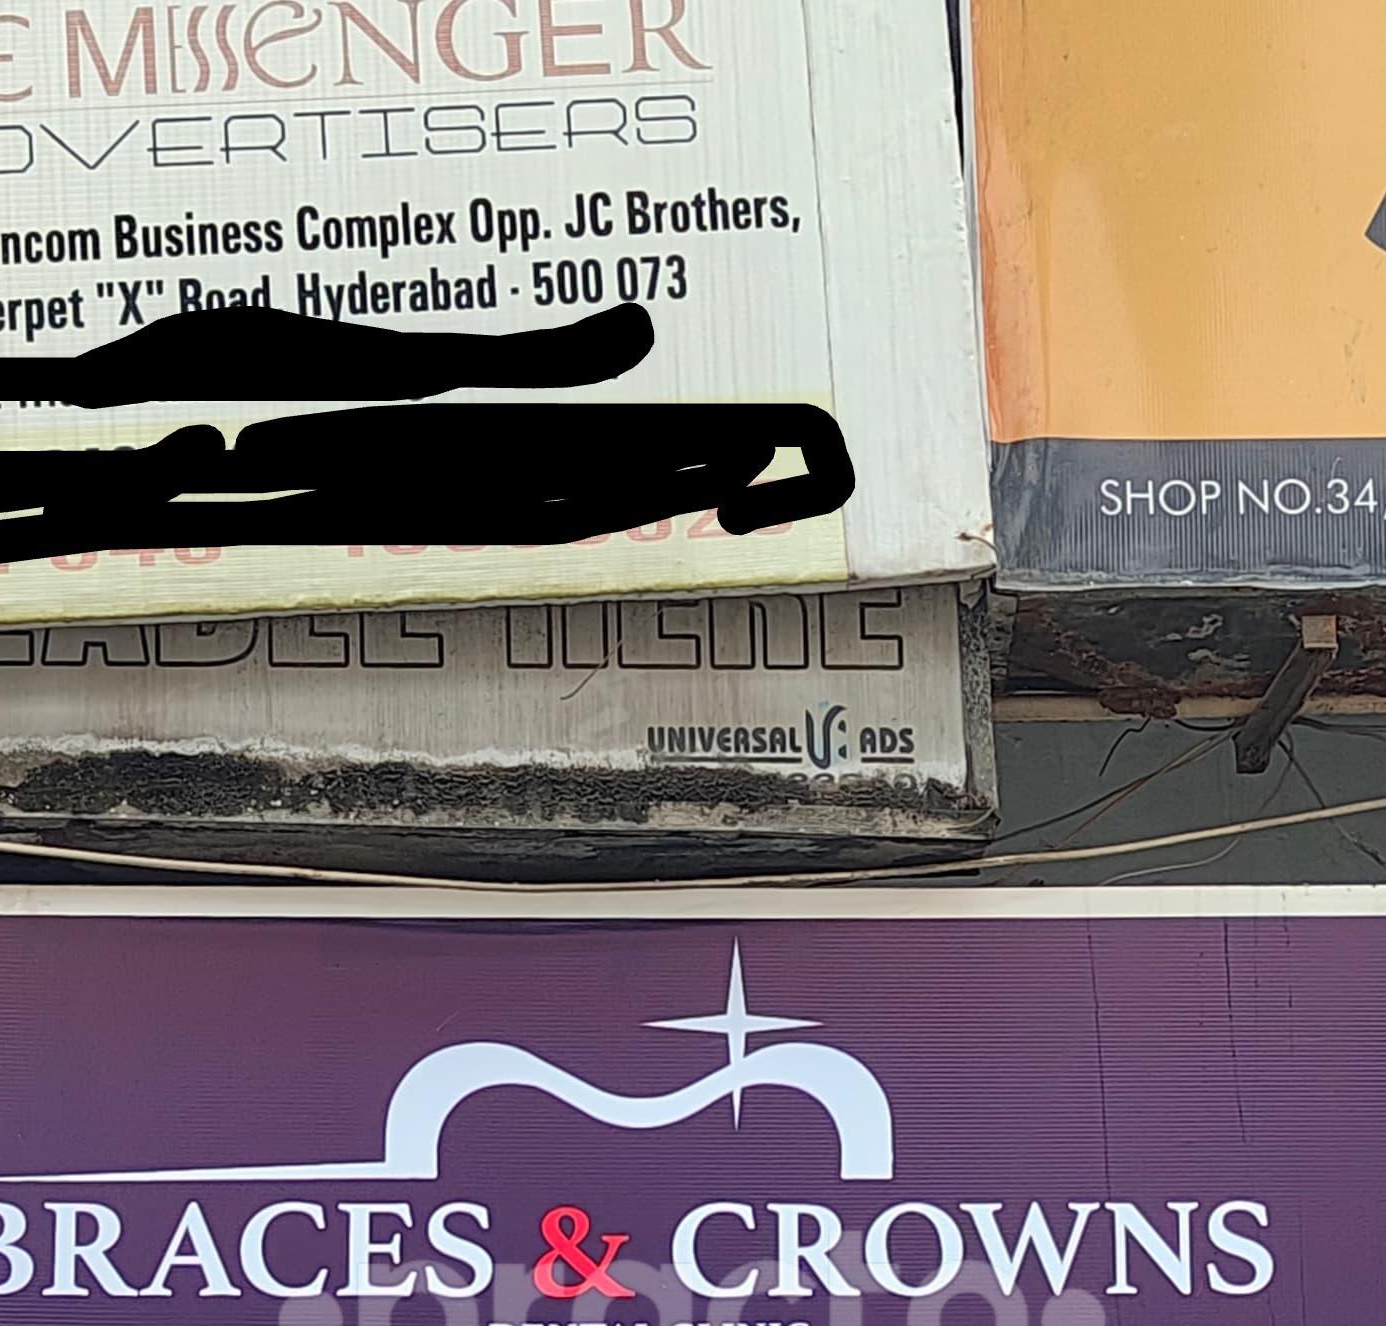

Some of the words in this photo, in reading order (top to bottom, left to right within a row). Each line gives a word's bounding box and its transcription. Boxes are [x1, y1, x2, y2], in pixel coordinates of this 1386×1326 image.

[113, 211, 284, 259] Business
[296, 202, 457, 258] Complex
[469, 198, 552, 252] Opp.
[564, 192, 613, 239] JC
[626, 188, 802, 236] Brothers,
[296, 266, 498, 322] Hyderabad
[532, 258, 605, 306] 500
[617, 254, 689, 303] 073
[1099, 478, 1222, 517] SHOP
[647, 726, 803, 754] UNIVERSAL
[859, 726, 915, 754] ADS
[532, 1206, 635, 1298] &
[670, 1200, 1275, 1298] CROWNS
